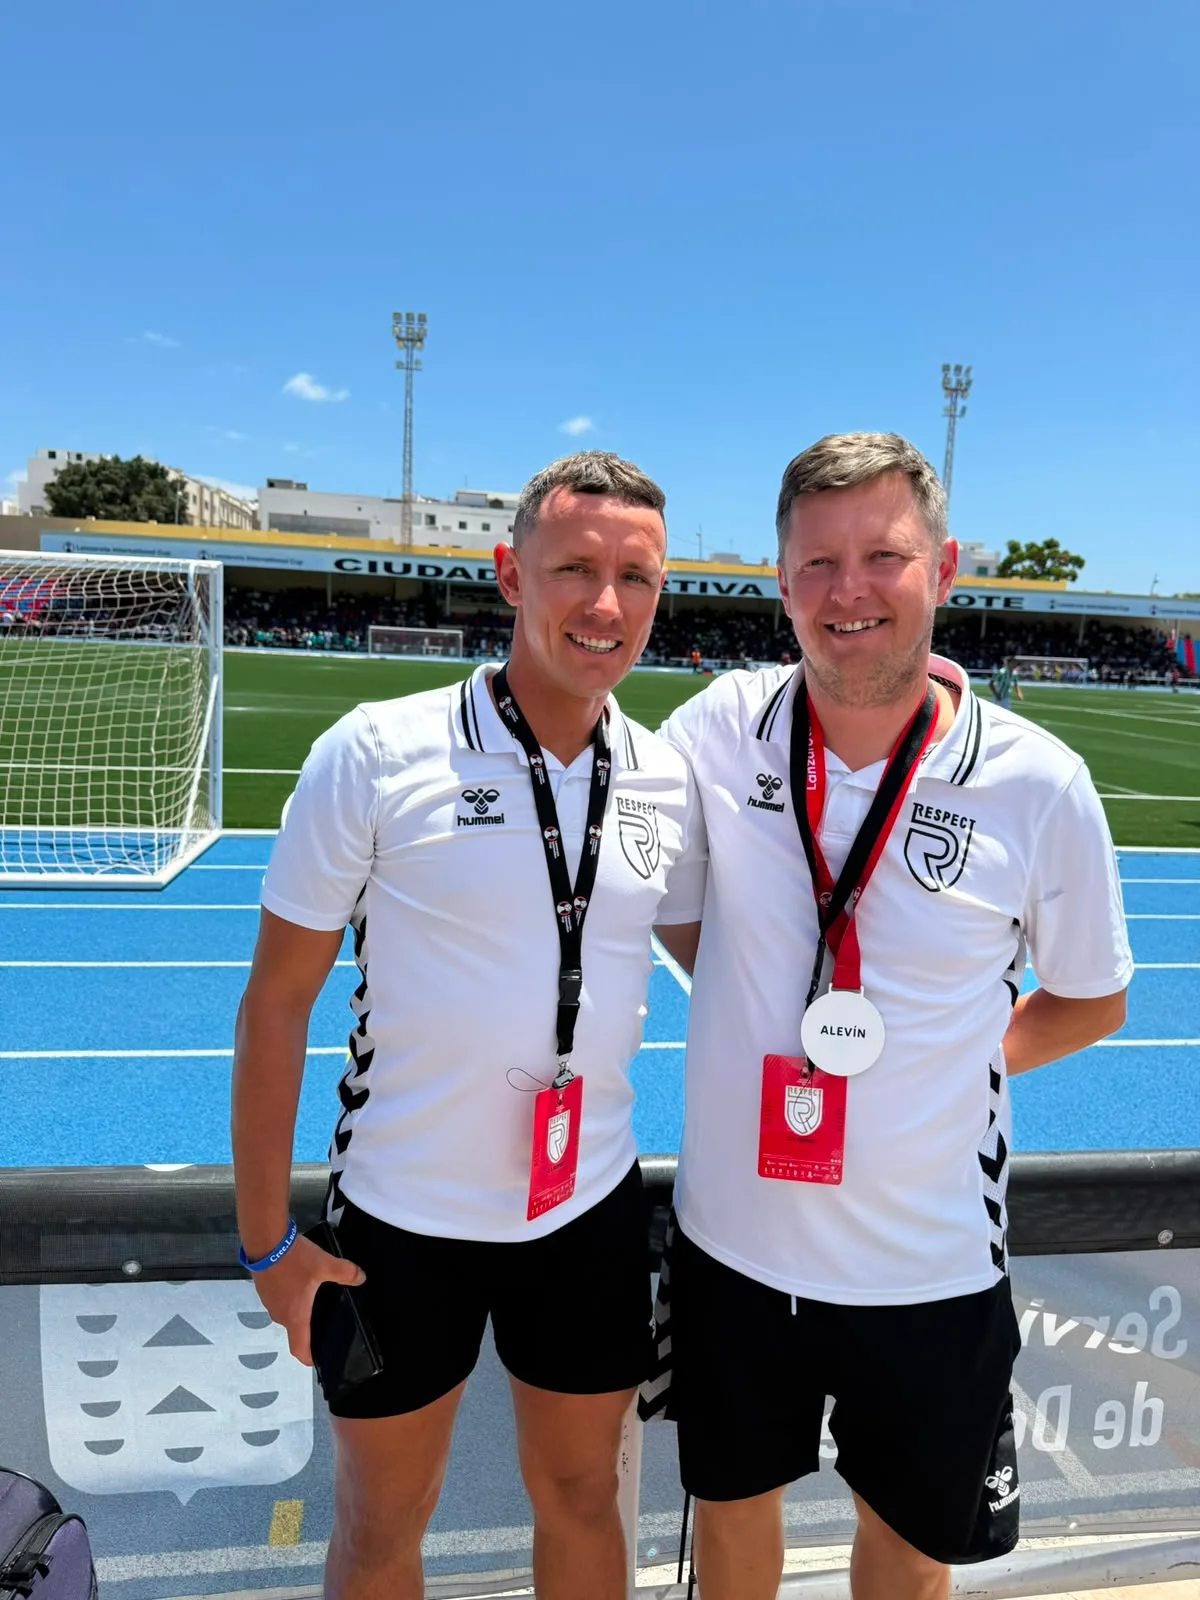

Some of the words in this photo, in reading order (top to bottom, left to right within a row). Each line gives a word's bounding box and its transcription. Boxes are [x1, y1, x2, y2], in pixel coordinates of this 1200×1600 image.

[949, 594, 1025, 611] OTE
[615, 796, 657, 816] RESPECT
[747, 795, 785, 814] hummel
[457, 812, 505, 827] hummel
[911, 802, 976, 830] RESPECT
[820, 1024, 866, 1039] ALEVÍN
